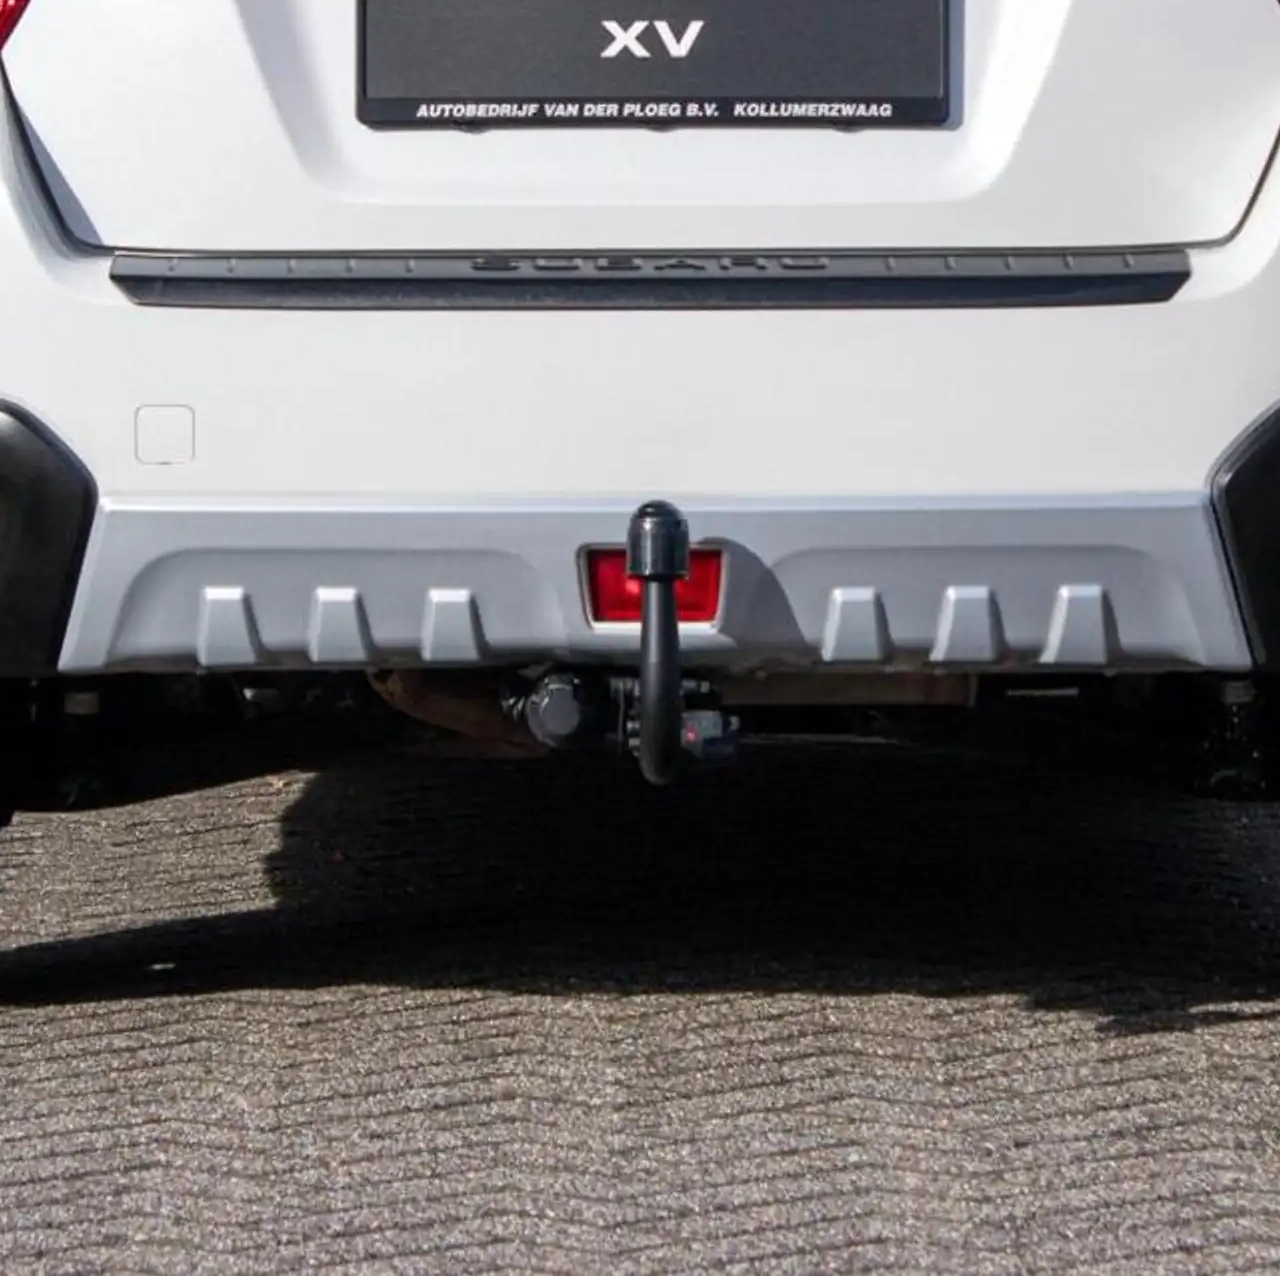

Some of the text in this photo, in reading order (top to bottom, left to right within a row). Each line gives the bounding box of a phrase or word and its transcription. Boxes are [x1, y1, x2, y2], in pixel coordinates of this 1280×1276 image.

[600, 20, 704, 58] XV
[416, 103, 892, 118] AUTOBEDRIJF VAN DER PLOEG B.V. KOLLUMERZWAAG
